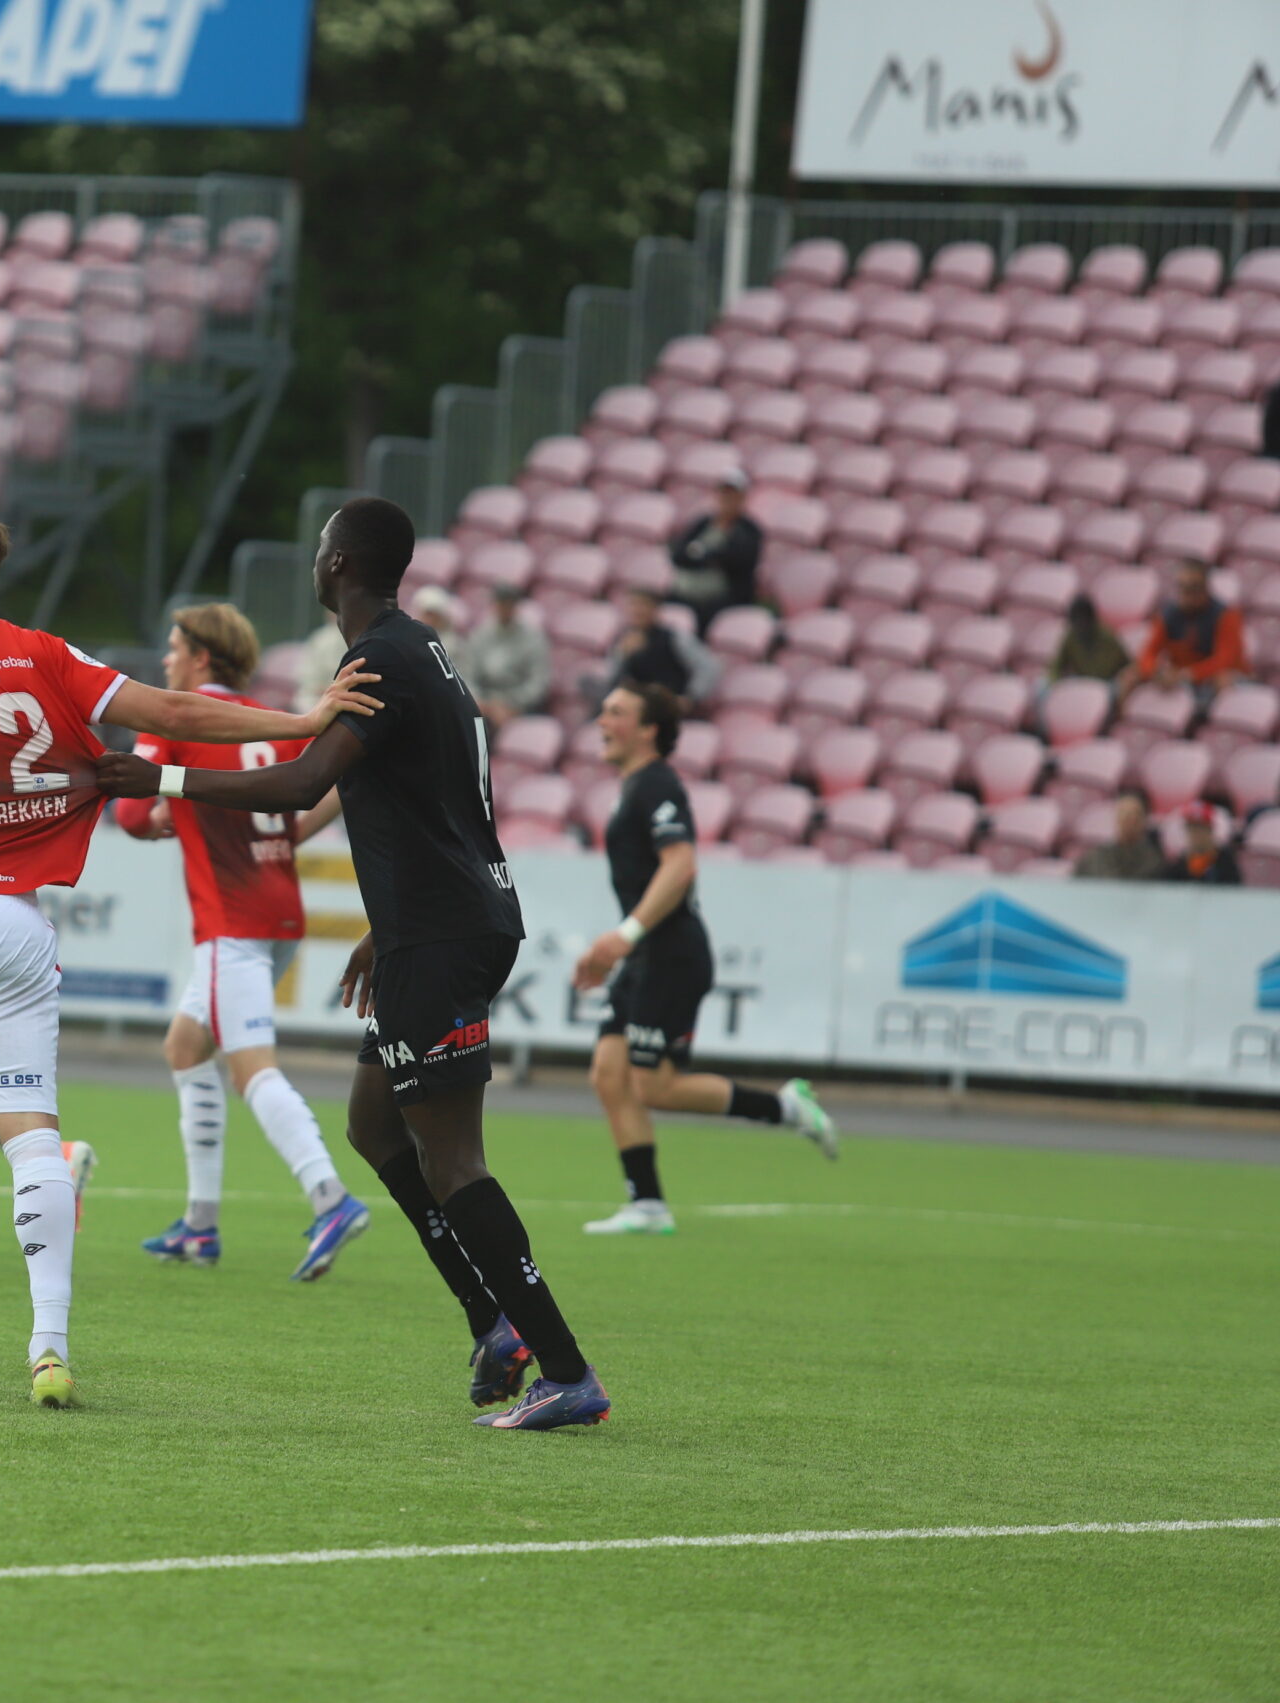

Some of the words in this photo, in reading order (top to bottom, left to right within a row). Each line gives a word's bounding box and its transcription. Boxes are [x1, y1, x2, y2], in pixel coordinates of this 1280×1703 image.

[848, 50, 1082, 147] Manis
[874, 1001, 1147, 1066] PRE-CON
[378, 1039, 416, 1069] VA
[423, 1053, 448, 1065] ÅSANE
[14, 1075, 43, 1085] ØST
[393, 1079, 414, 1092] CRAFT
